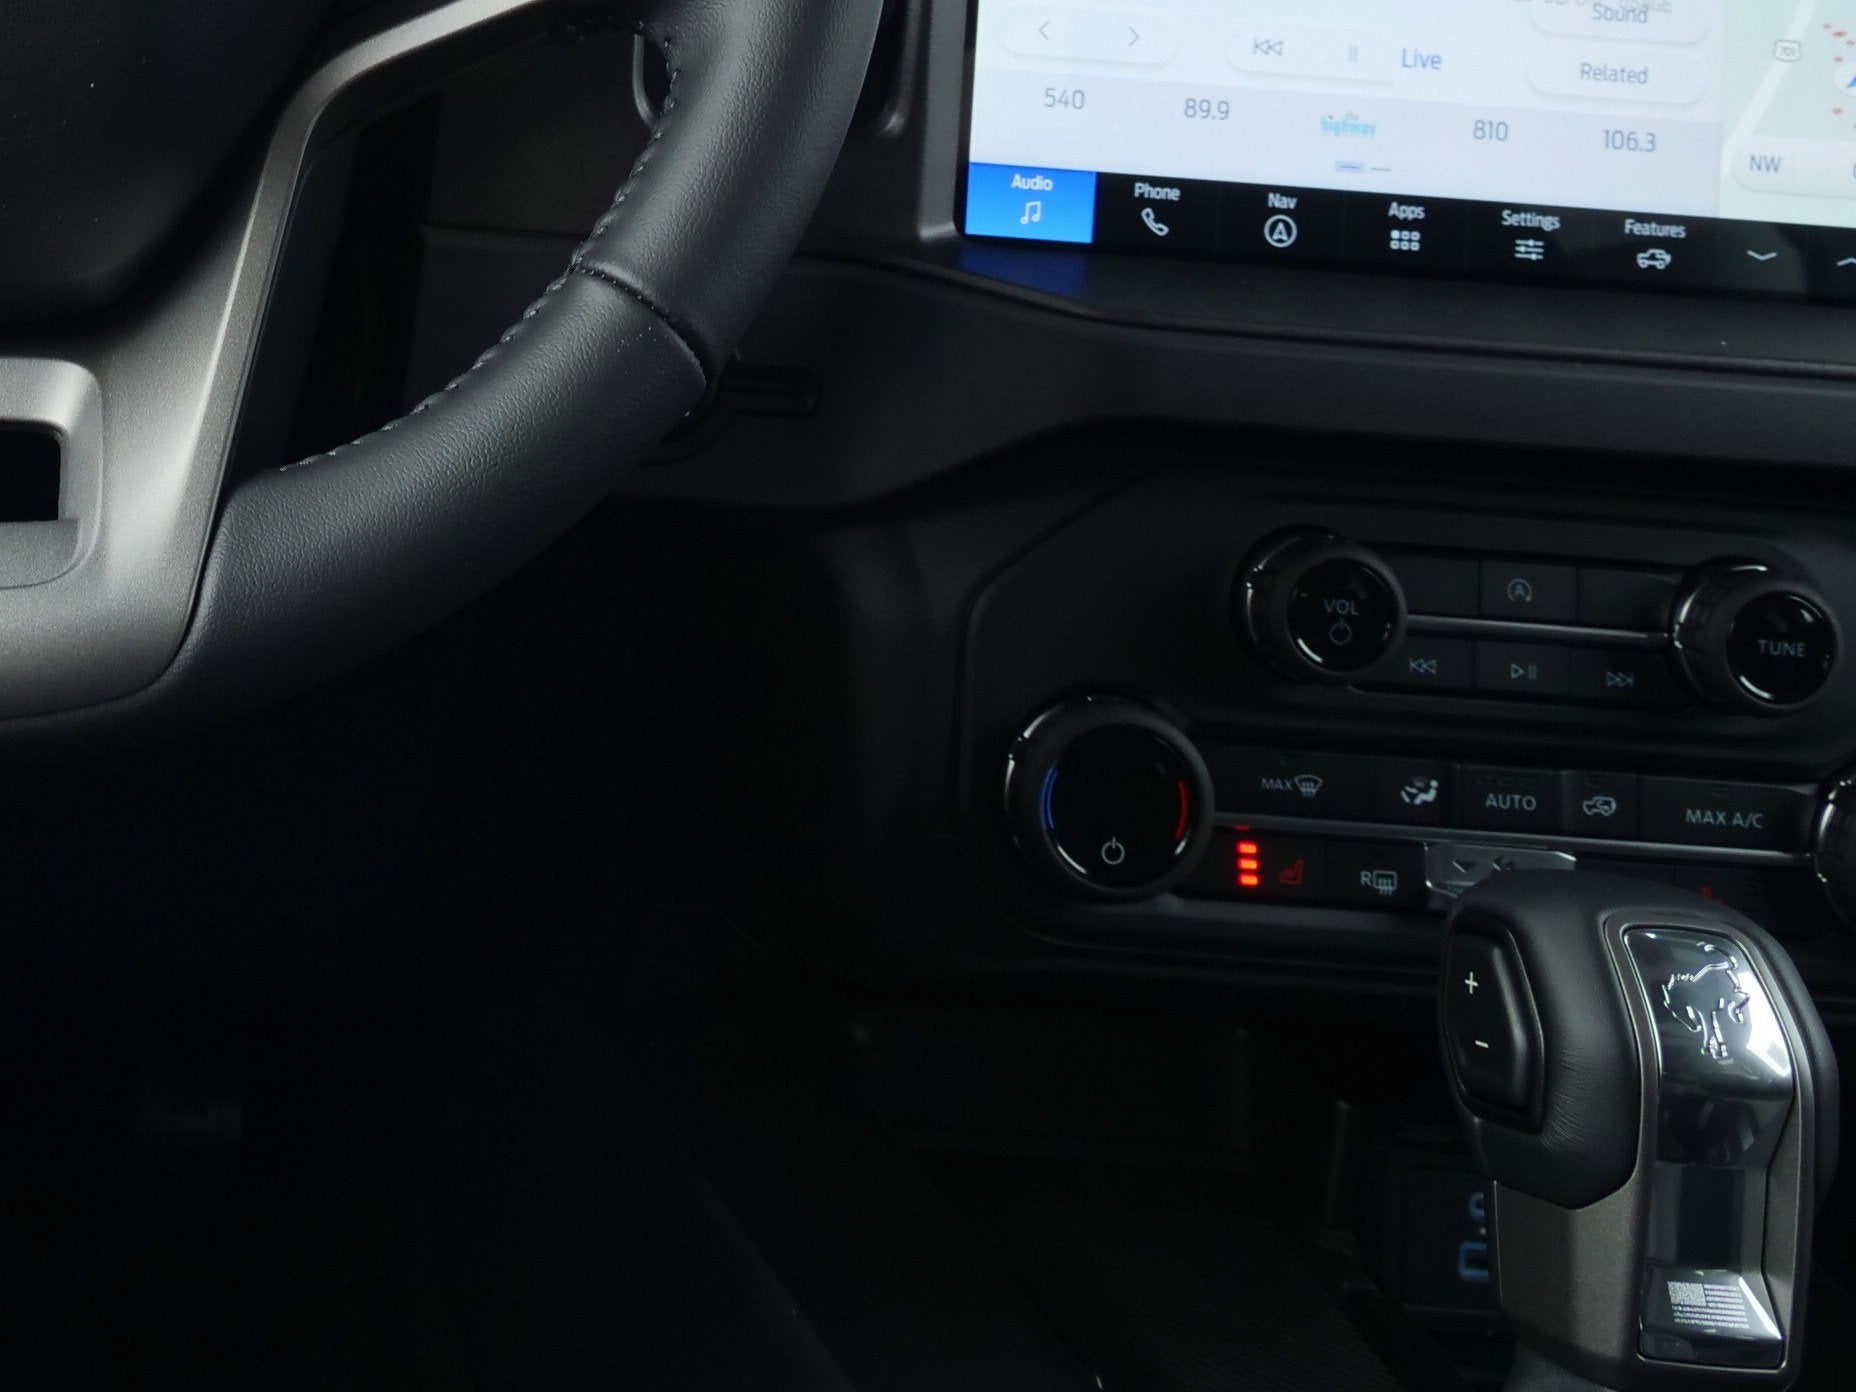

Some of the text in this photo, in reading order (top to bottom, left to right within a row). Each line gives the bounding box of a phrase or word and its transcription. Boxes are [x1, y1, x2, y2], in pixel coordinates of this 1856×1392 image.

[1591, 2, 1650, 24] Sound
[1401, 48, 1443, 72] Live
[1579, 62, 1650, 85] Related
[1043, 87, 1086, 110] 540
[1183, 97, 1231, 121] 89.9
[1472, 119, 1509, 142] 810
[1604, 129, 1657, 153] 106.3
[1749, 155, 1782, 173] NW
[1011, 173, 1053, 193] Audio
[1134, 181, 1181, 202] Phone
[1268, 192, 1298, 210] Nav
[1388, 201, 1425, 222] Apps
[1501, 209, 1562, 232] Settings
[1624, 218, 1687, 240] Features
[1323, 596, 1360, 617] VOL
[1757, 637, 1807, 659] TUNE
[1260, 774, 1293, 793] MAX
[1484, 791, 1538, 812] AUTO
[1685, 808, 1764, 831] MAX A/C
